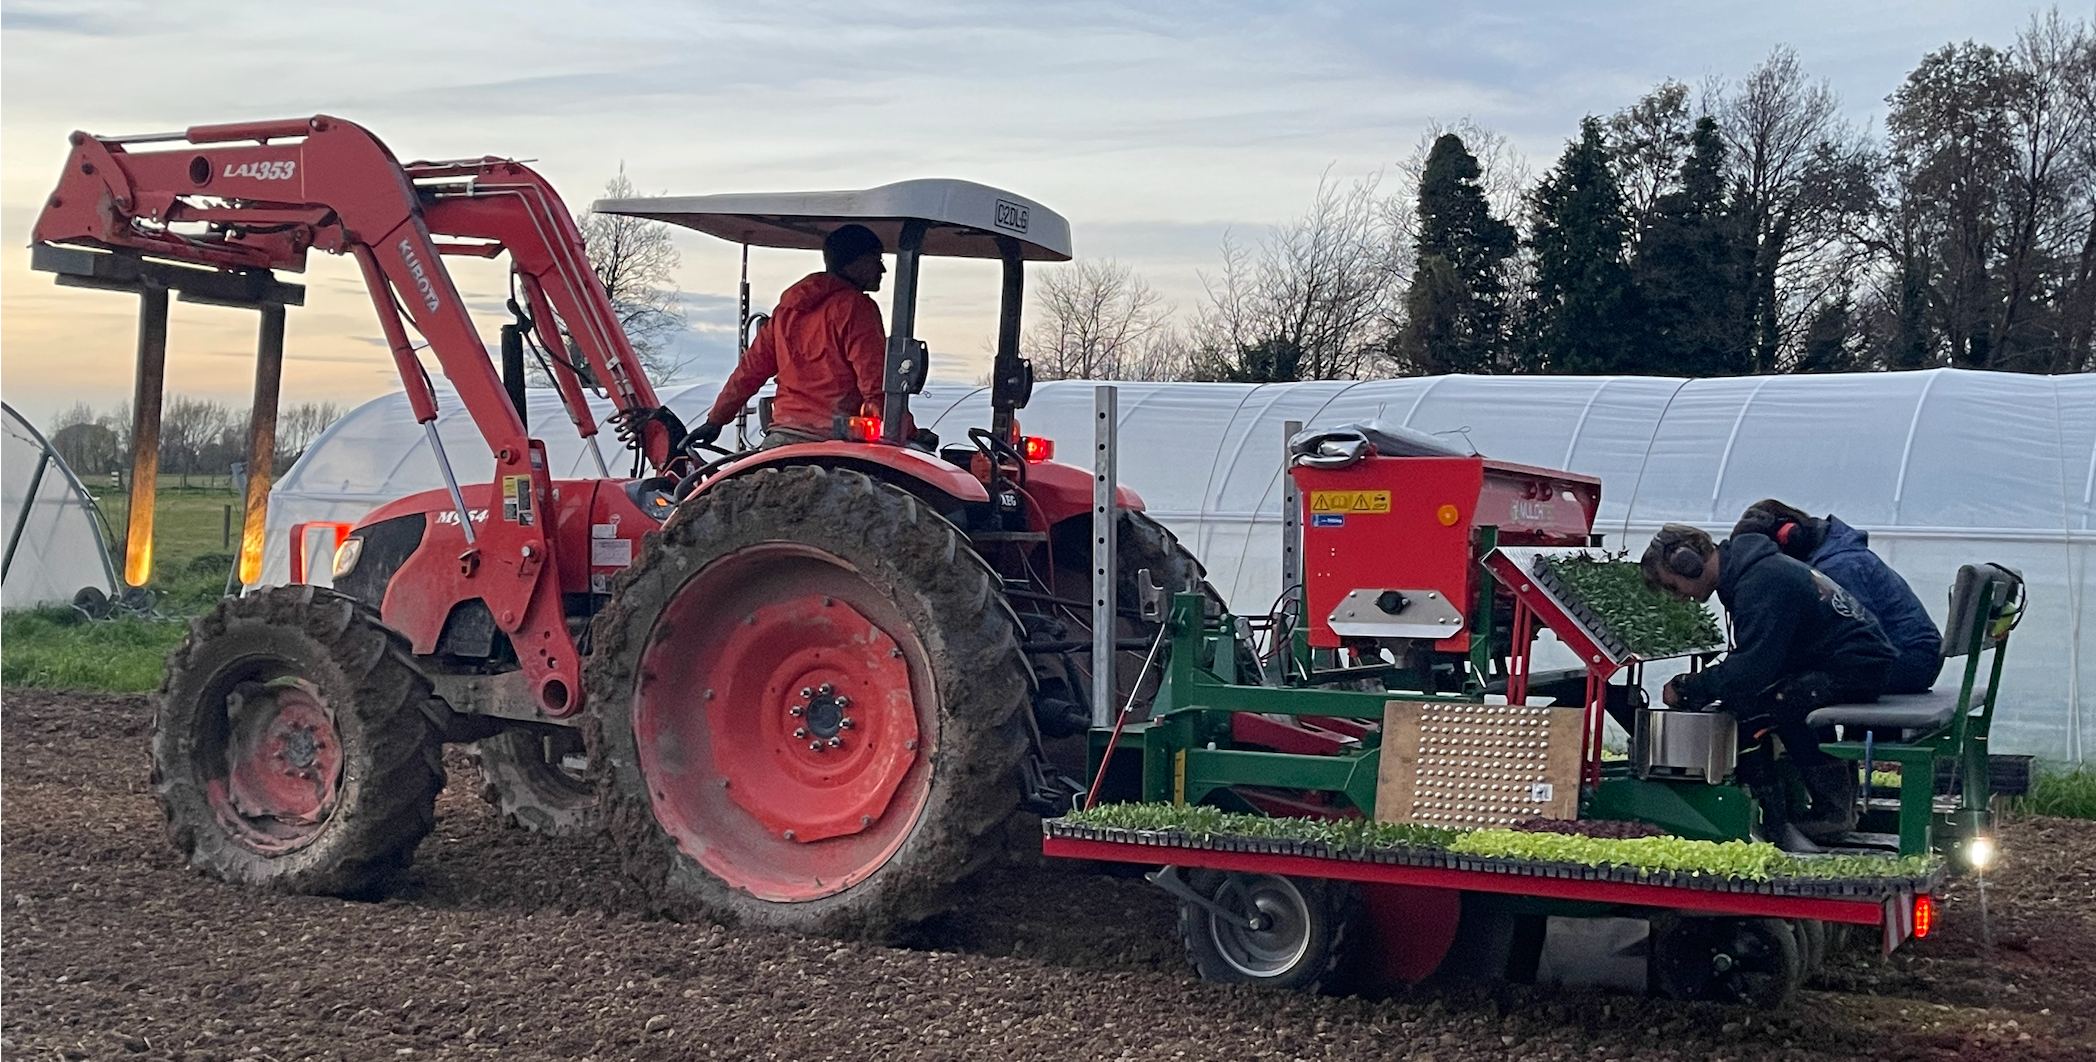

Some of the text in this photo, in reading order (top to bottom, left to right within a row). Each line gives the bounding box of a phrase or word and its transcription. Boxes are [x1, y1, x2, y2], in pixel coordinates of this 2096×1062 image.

[222, 160, 296, 181] LA1353
[398, 238, 440, 313] KUBOTA
[434, 509, 490, 526] M954
